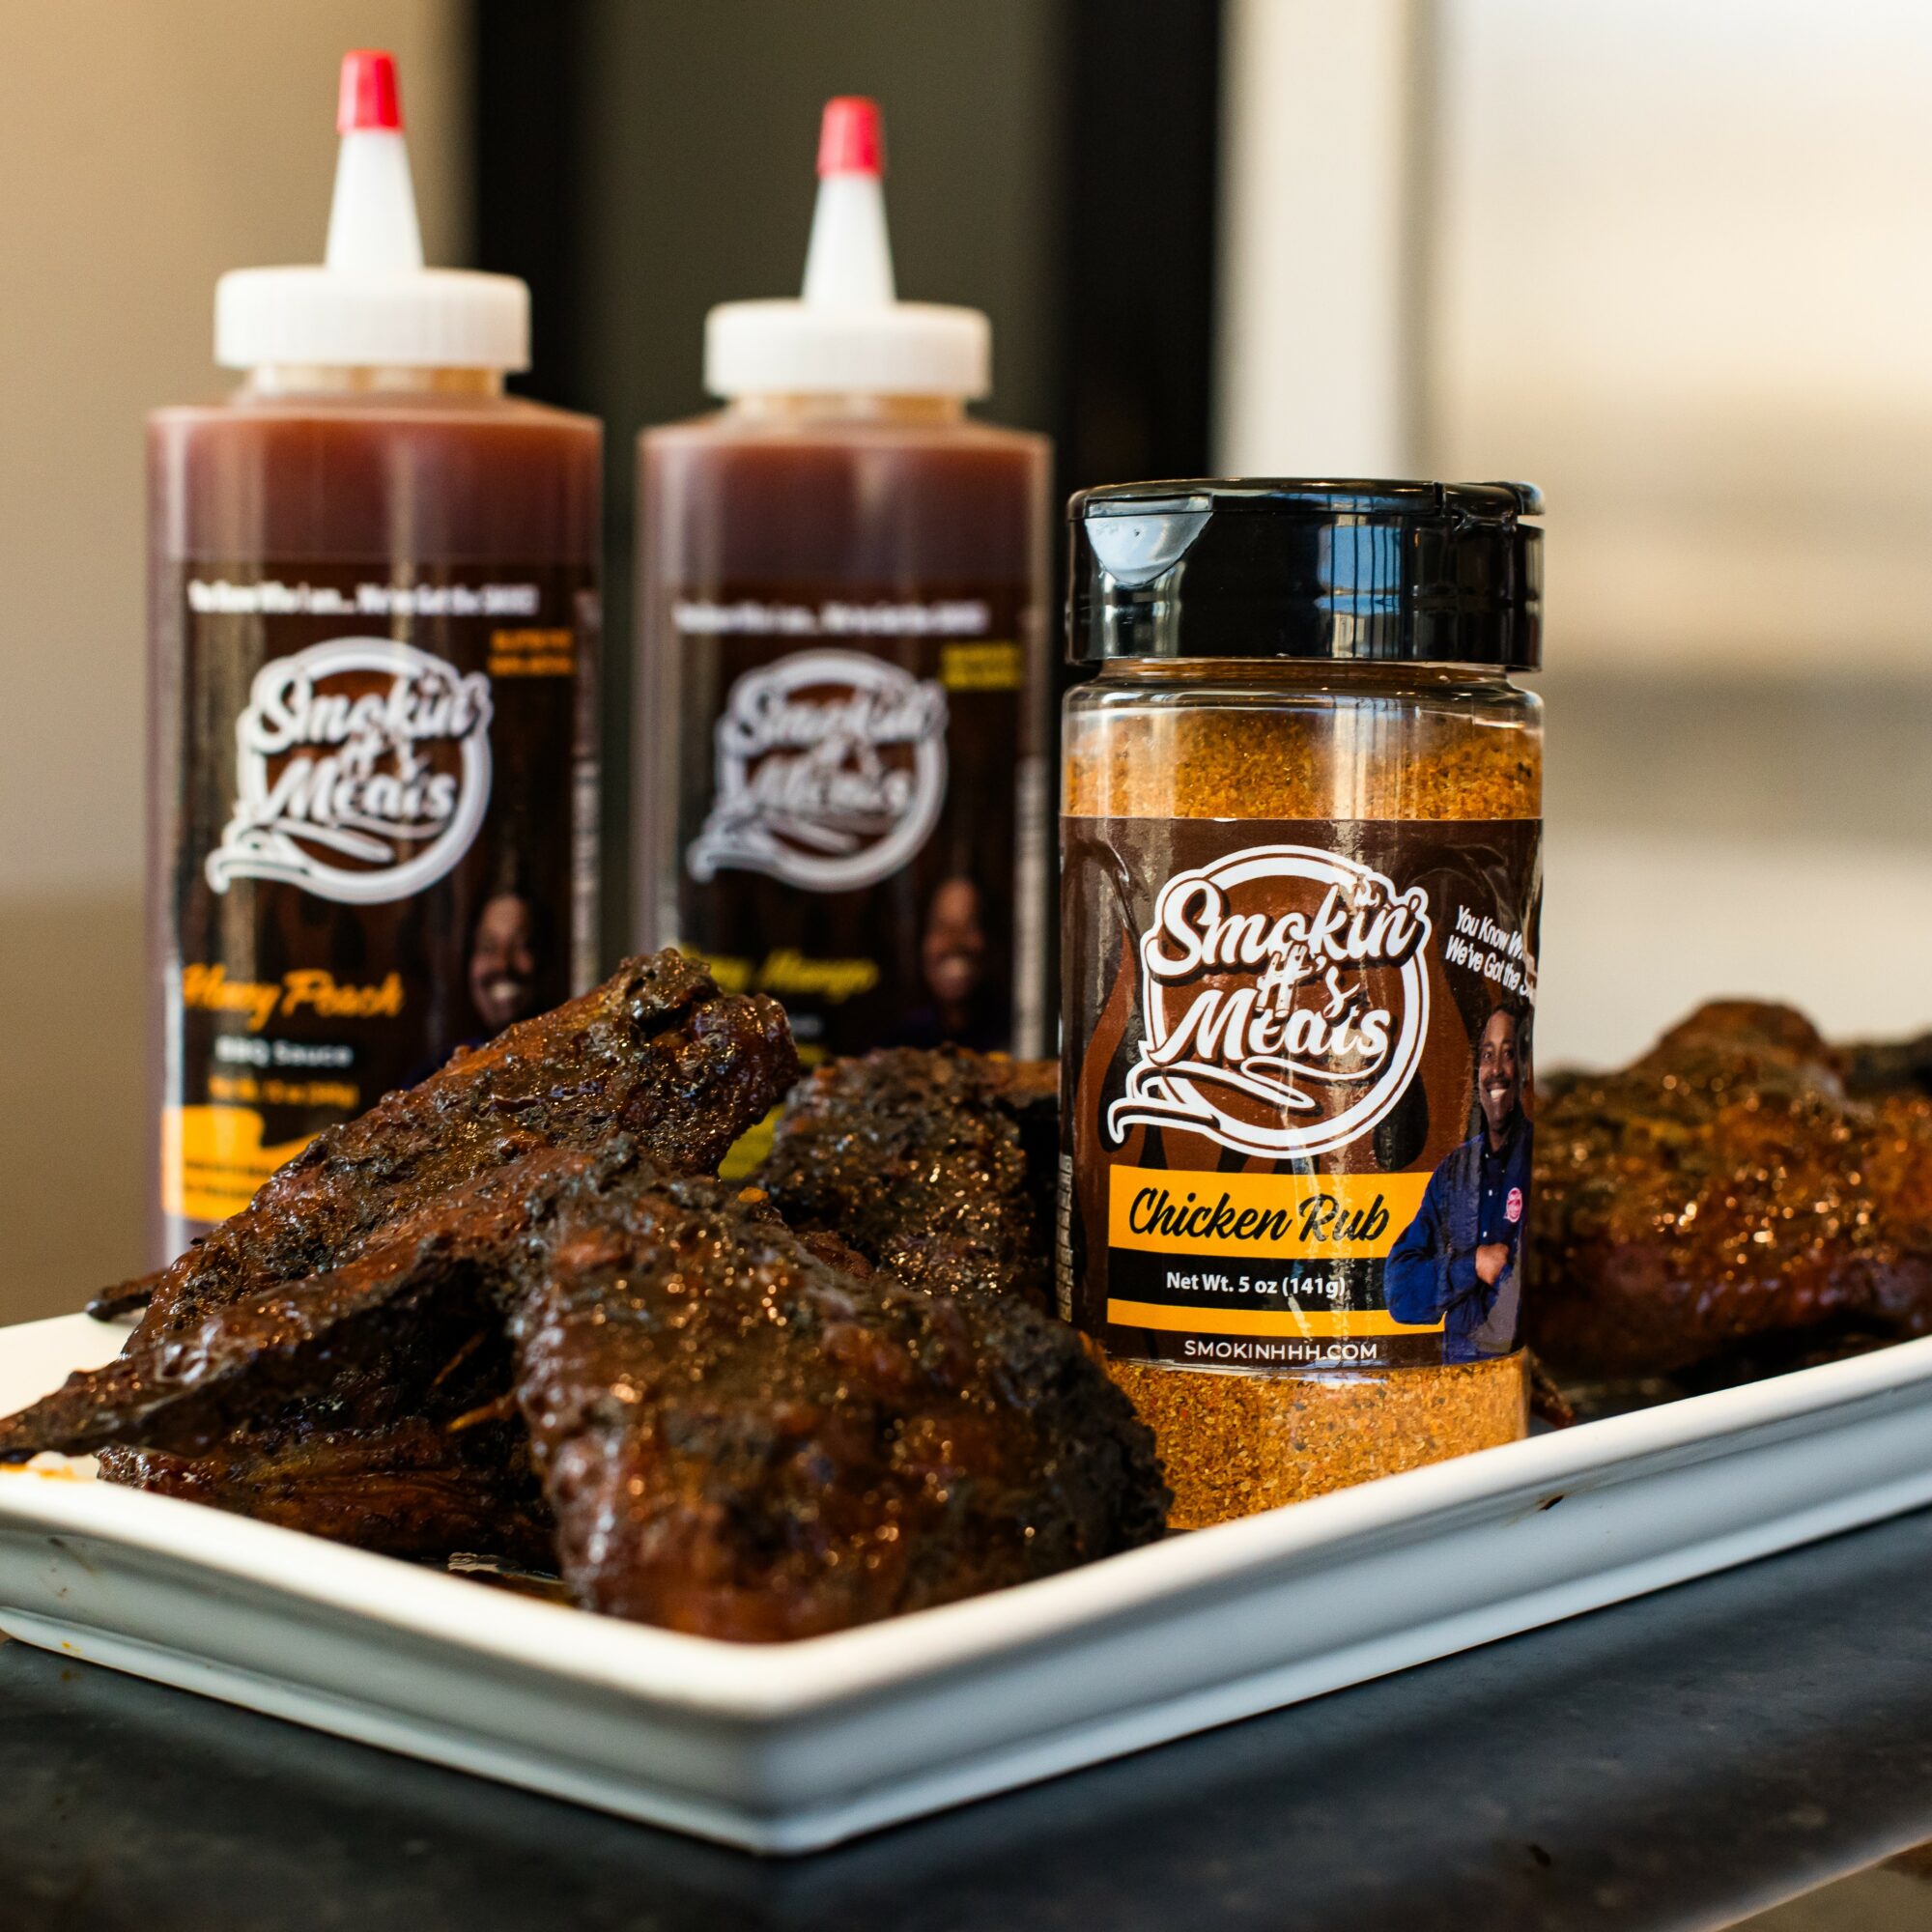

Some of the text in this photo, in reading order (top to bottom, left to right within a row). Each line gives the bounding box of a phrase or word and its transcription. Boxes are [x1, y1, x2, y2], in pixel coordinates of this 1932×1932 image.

[1146, 873, 1421, 978] Smokin'
[1456, 904, 1480, 937] You
[1477, 916, 1511, 952] Know
[1445, 934, 1484, 973] We've
[1484, 952, 1505, 983] Got
[1502, 963, 1521, 991] the
[1148, 987, 1391, 1065] Meats
[1128, 1187, 1390, 1242] Chicken Rub
[1166, 1272, 1347, 1299] Net Wt. 5 oz (141g)
[1183, 1340, 1378, 1361] SMOKINHHH.COM
